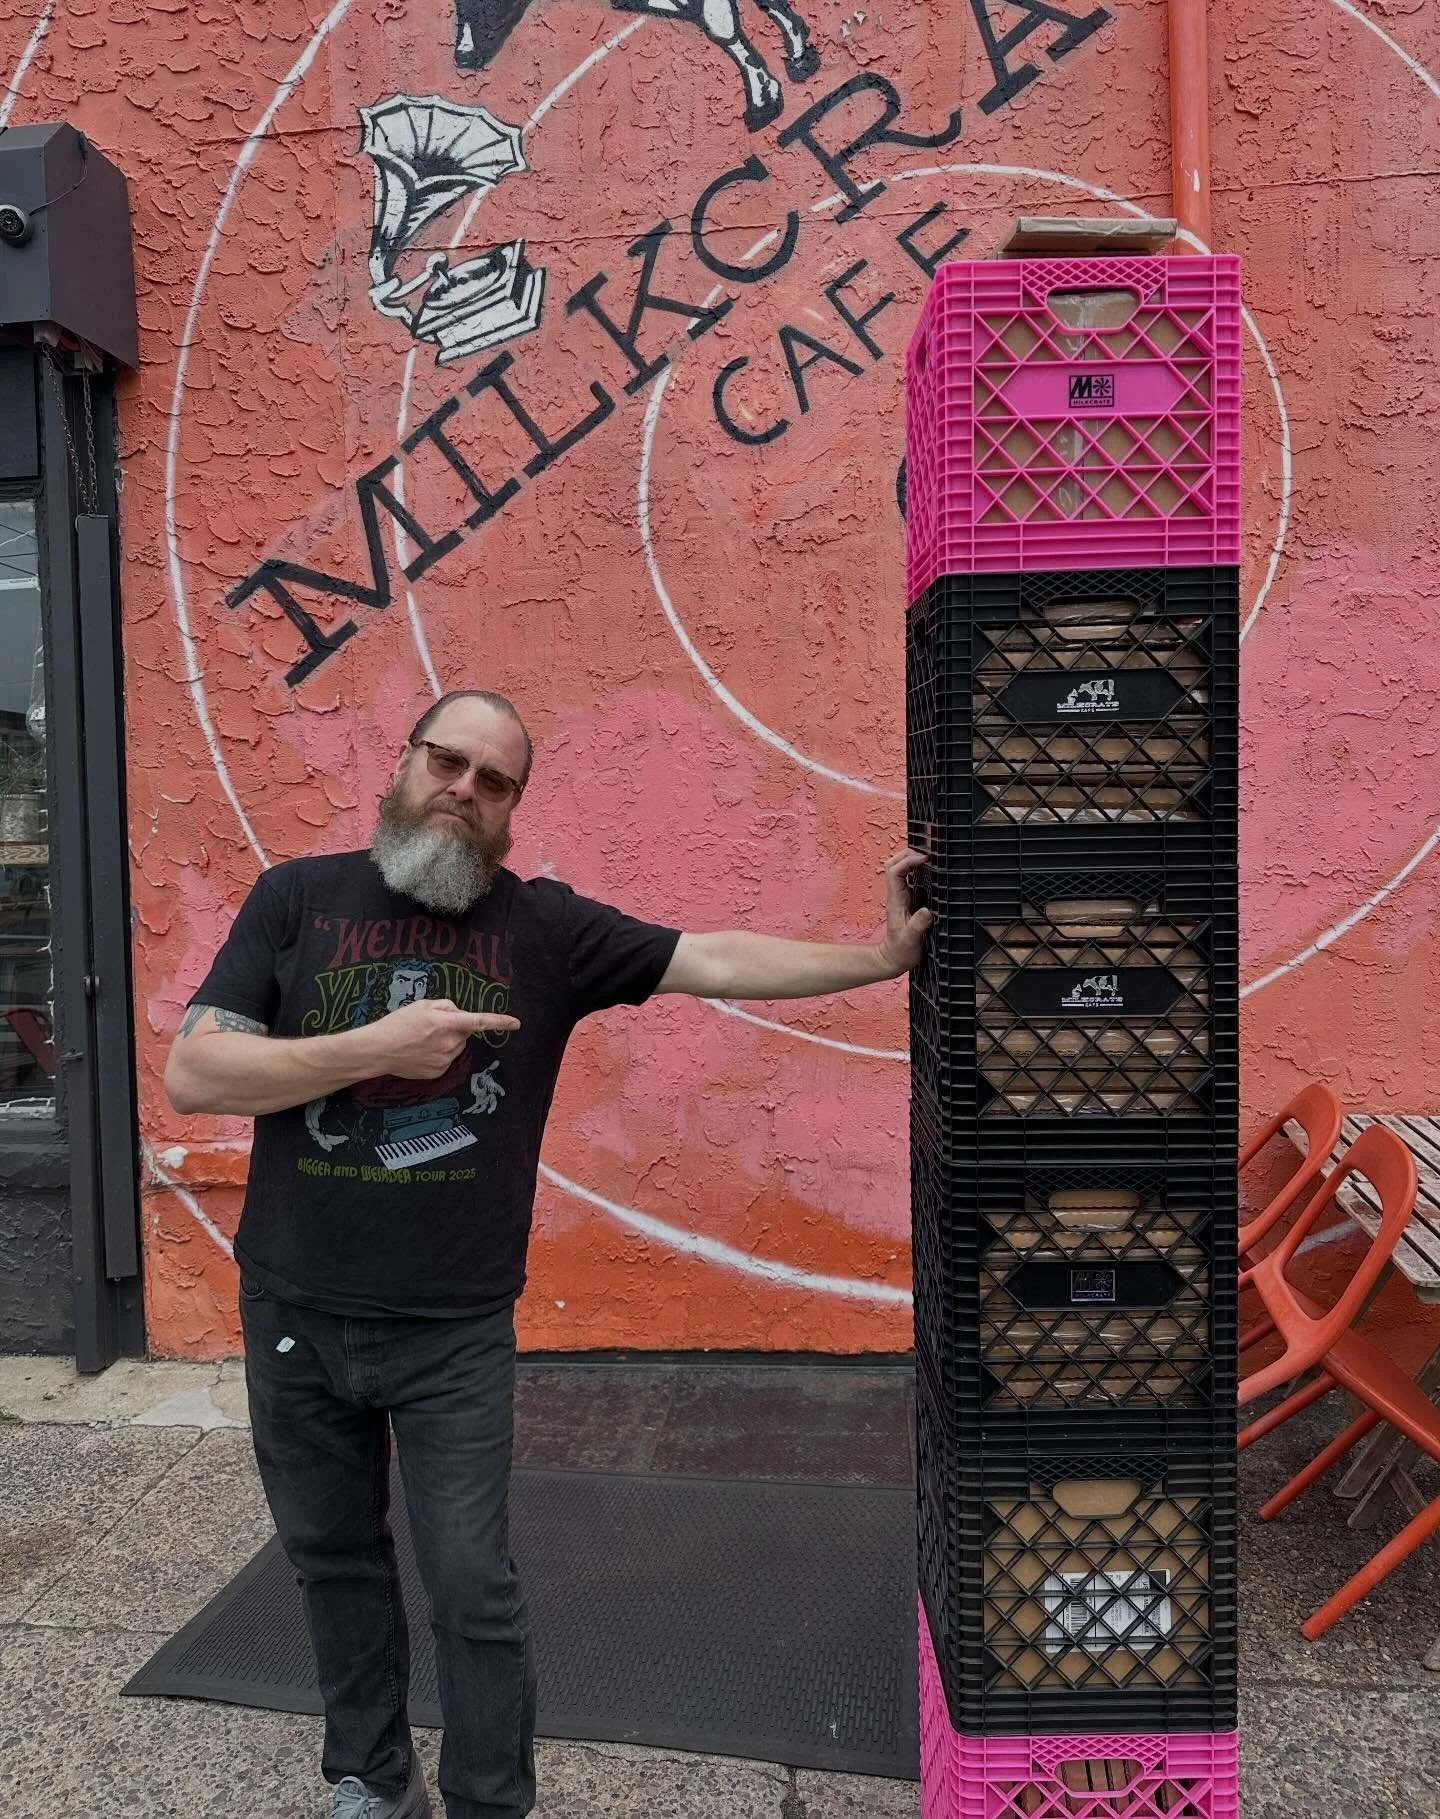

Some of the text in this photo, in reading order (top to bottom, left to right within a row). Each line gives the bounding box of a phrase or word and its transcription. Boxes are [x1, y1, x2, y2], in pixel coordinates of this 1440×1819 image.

[302, 958, 511, 1049] YAVIC
[297, 1156, 478, 1184] BIGGER AND WEIRDER TOUR 2025
